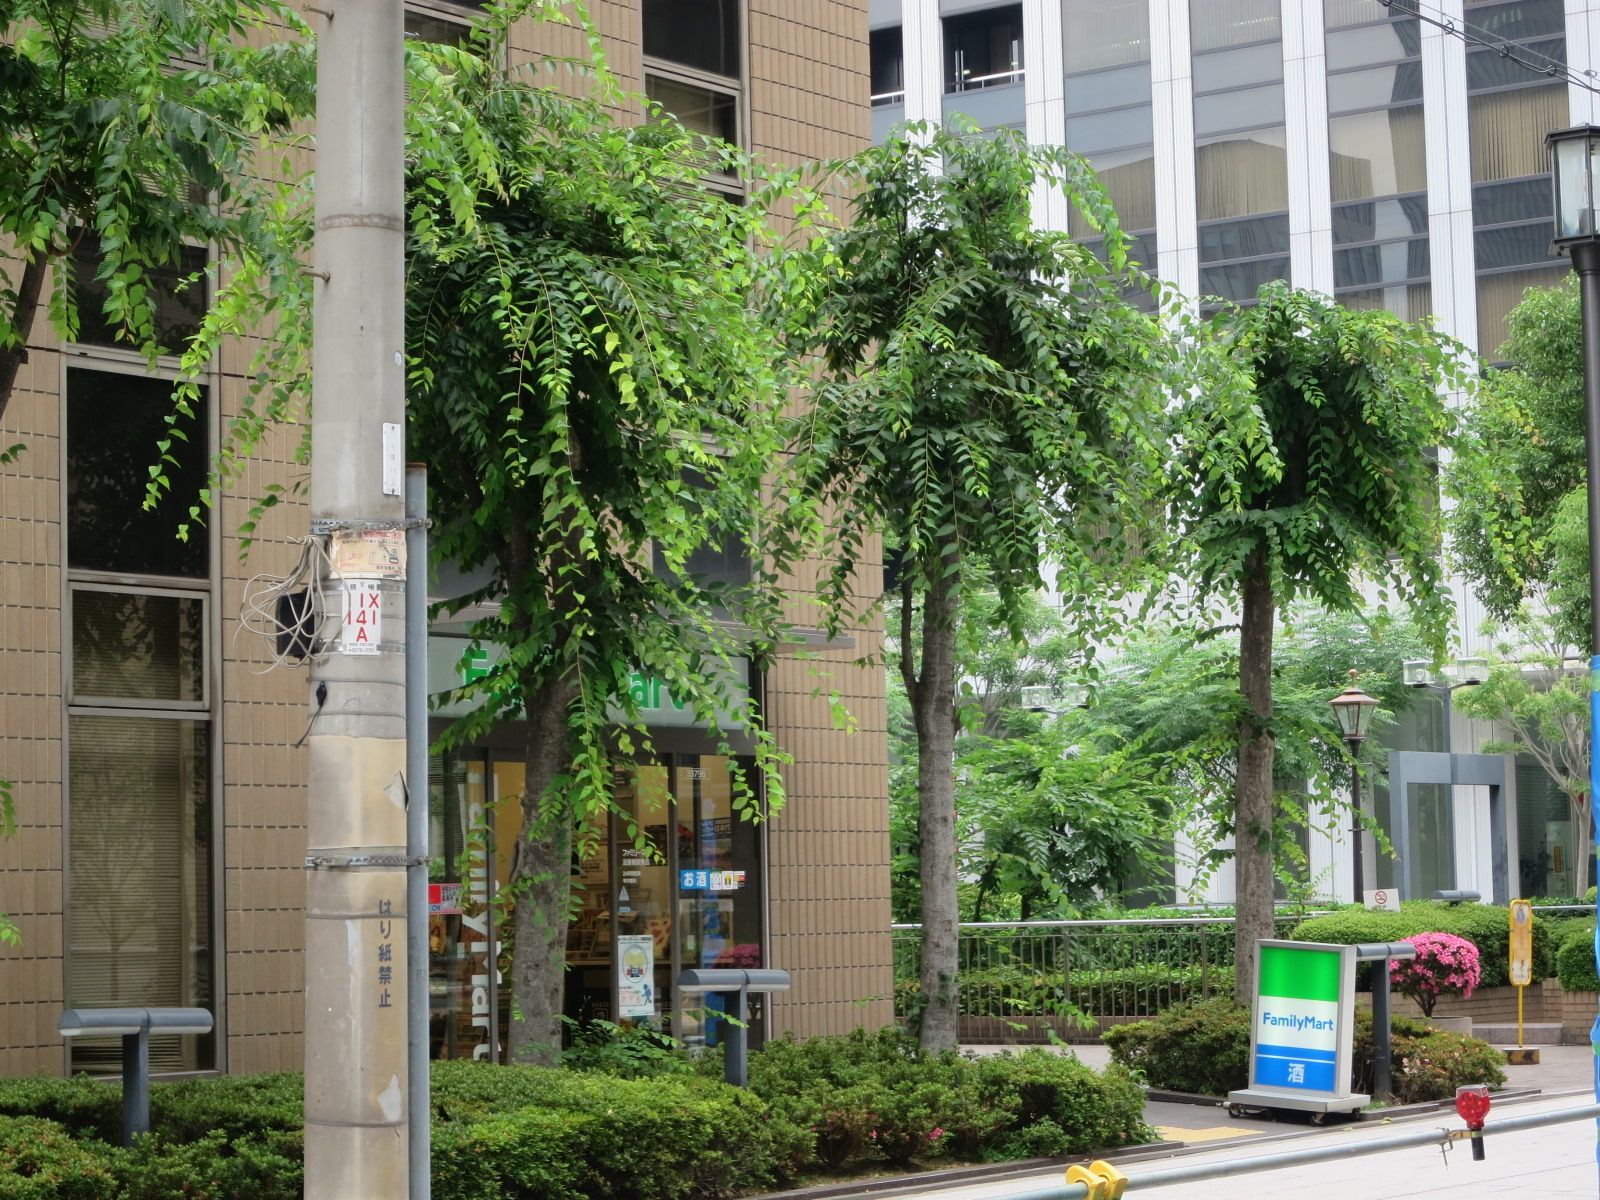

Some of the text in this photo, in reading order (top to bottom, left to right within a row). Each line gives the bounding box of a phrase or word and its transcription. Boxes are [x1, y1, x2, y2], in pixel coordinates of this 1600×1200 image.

[356, 626, 368, 642] A
[683, 871, 707, 887] お酒
[378, 898, 393, 1008] はり紙禁止
[1262, 1011, 1334, 1032] FamilyMart
[1287, 1062, 1305, 1084] 酒
